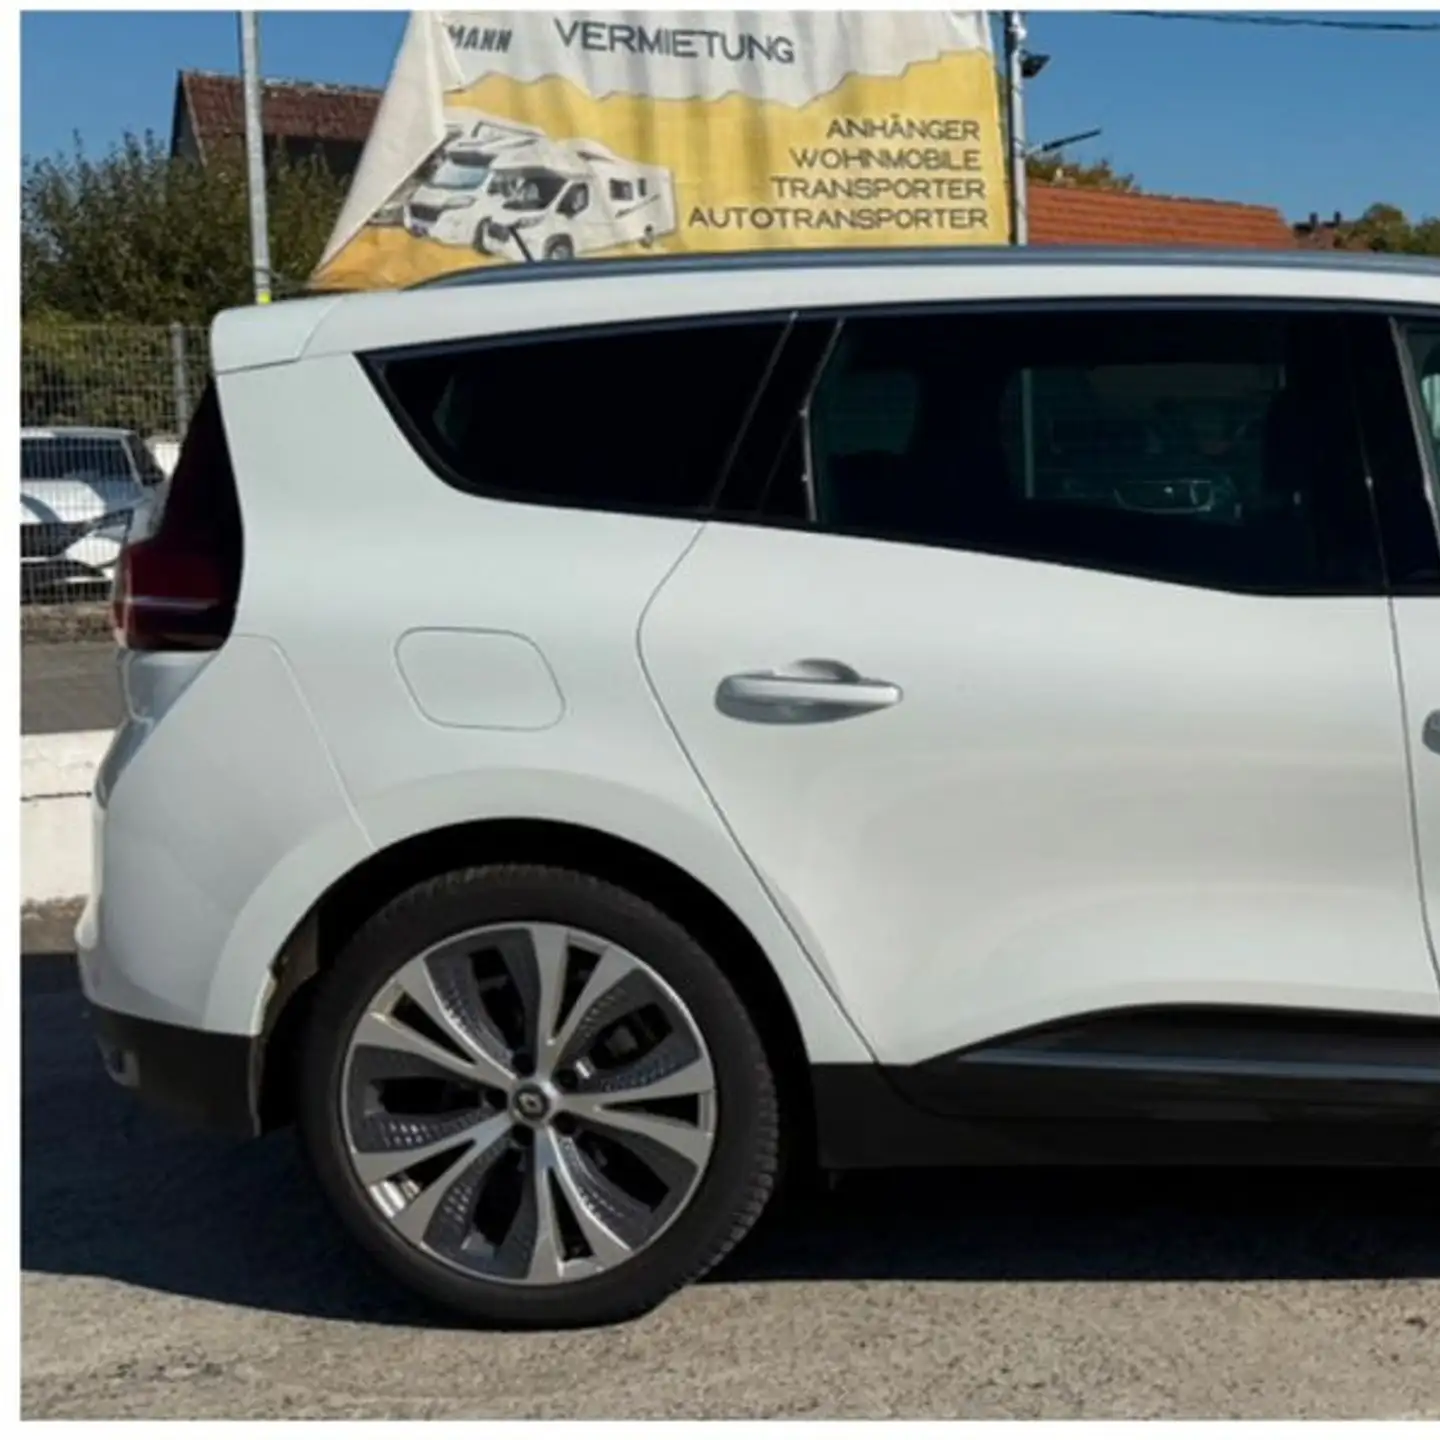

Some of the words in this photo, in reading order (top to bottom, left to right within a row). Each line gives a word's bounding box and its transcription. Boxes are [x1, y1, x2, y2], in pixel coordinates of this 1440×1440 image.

[554, 18, 796, 64] VERMIETUNG
[826, 114, 981, 141] ANHÄNGER
[789, 148, 983, 172] WOHNMOBILE
[771, 176, 987, 200] TRANSPORTER
[688, 207, 990, 230] AUTOTRANSPORTER
